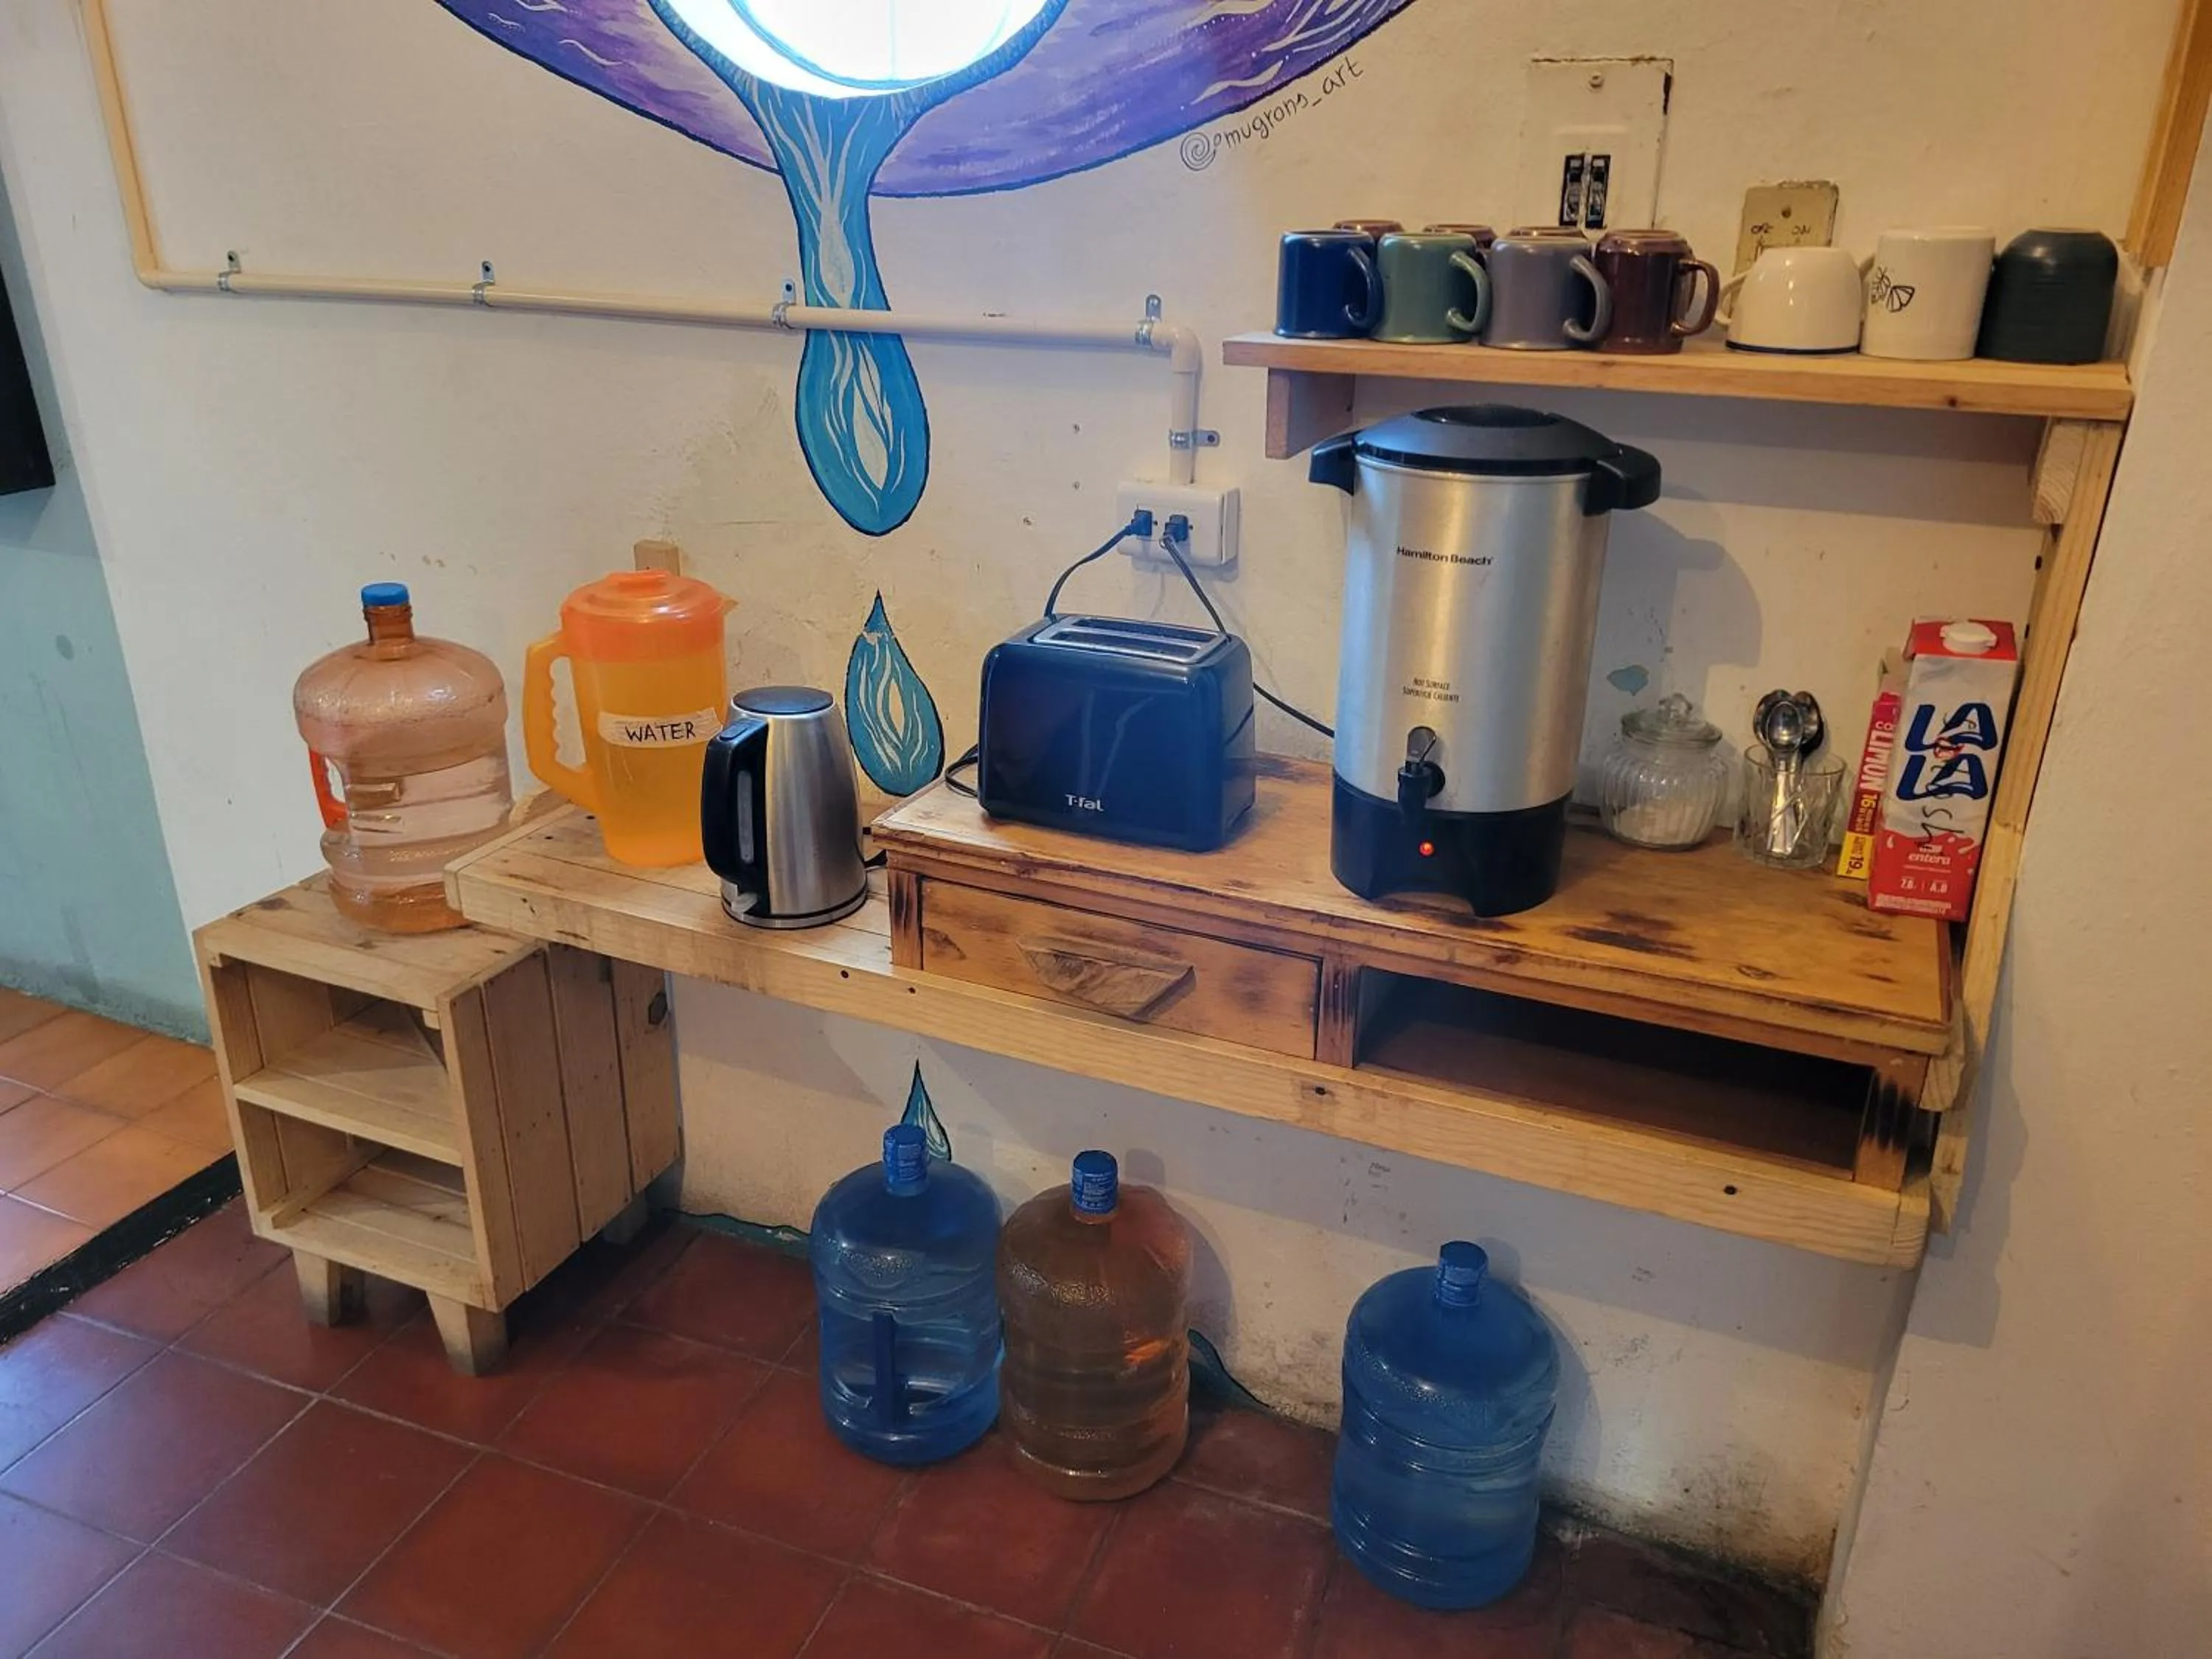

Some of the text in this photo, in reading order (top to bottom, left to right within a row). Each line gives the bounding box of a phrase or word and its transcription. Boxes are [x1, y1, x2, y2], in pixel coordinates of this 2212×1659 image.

[1397, 546, 1492, 566] Hamilton Beach
[625, 720, 696, 742] WATER
